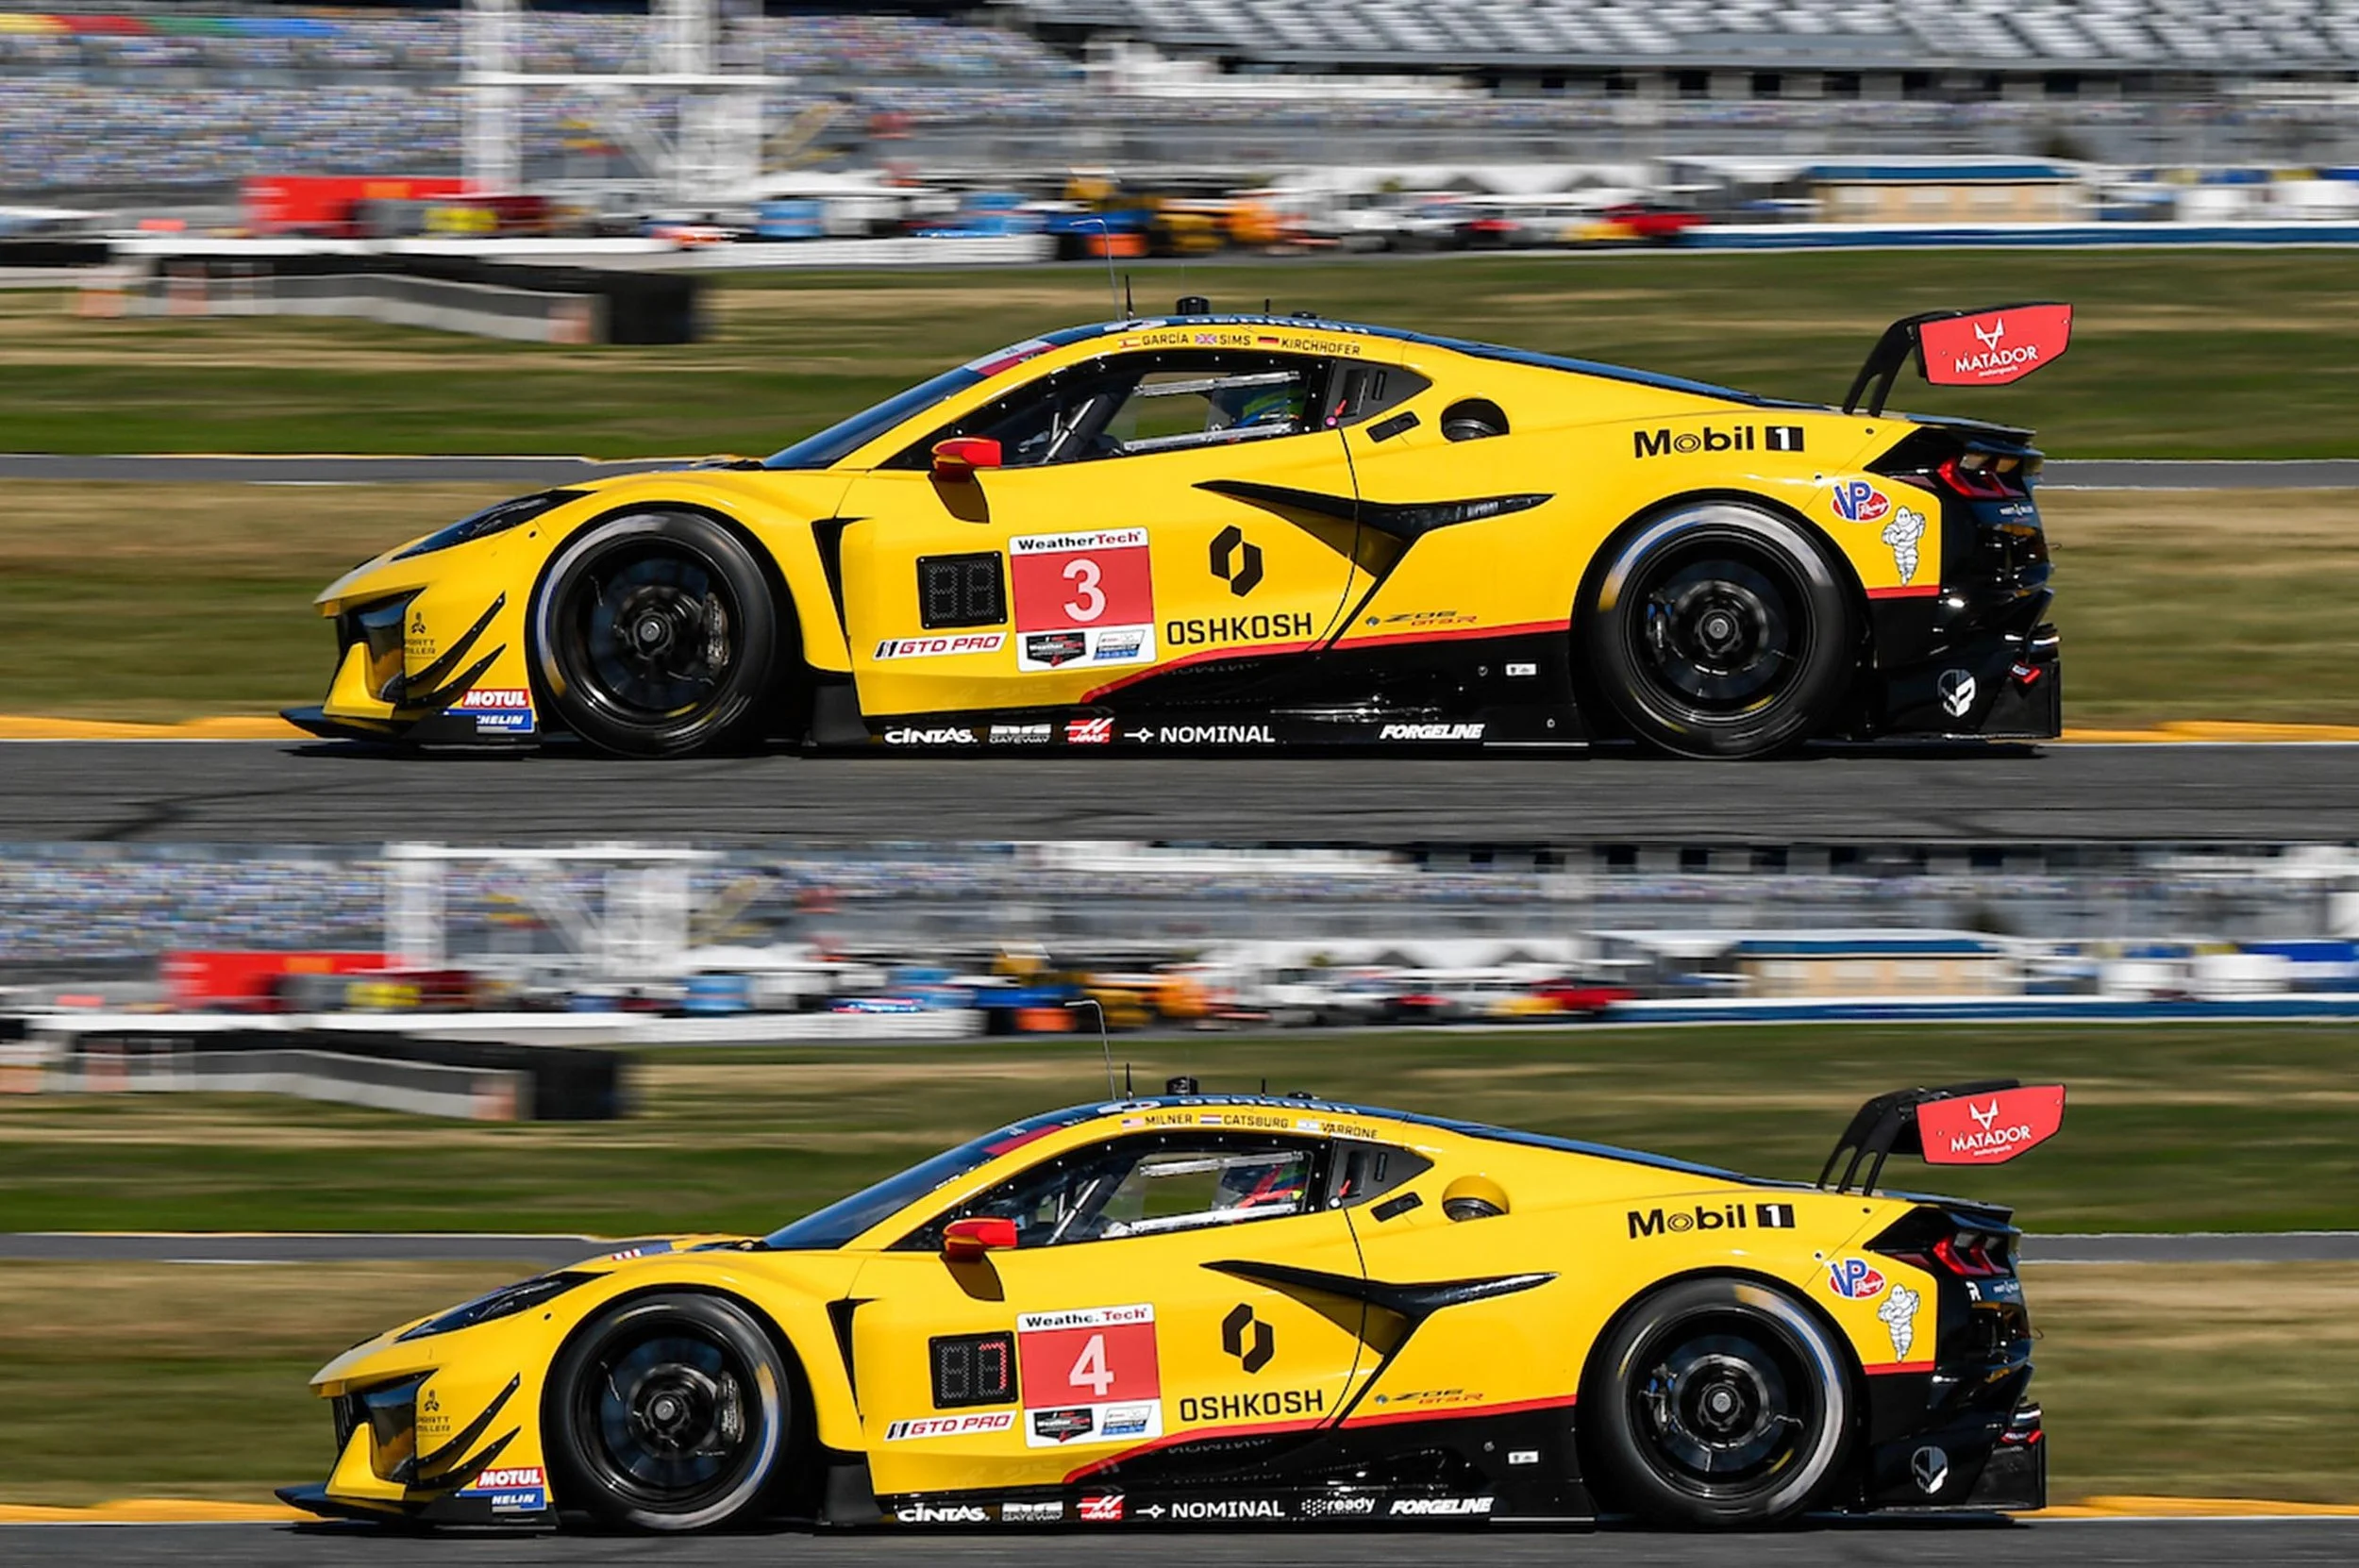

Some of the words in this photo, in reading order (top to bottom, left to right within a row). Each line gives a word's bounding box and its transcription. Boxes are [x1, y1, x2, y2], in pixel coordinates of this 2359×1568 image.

[1142, 332, 1189, 345] GARCÍA
[1220, 334, 1251, 346] SIMS
[1281, 337, 1360, 356] KIRCHHOFER
[1955, 345, 2038, 373] MATADOR
[1634, 426, 1754, 458] Mobil
[1834, 481, 1872, 520] VP
[1062, 559, 1107, 623] 3
[1167, 612, 1312, 645] OSHKOSH
[899, 640, 946, 655] GTD
[951, 636, 1001, 652] PRO
[464, 692, 527, 707] MOTUL
[1161, 725, 1276, 743] NOMINAL
[1380, 724, 1484, 741] FORGELINE
[1146, 1113, 1193, 1126] MILNER
[1224, 1114, 1289, 1129] CATSBURG
[1950, 1125, 2031, 1153] MATADOR
[1628, 1204, 1746, 1239] Mobil
[1832, 1259, 1868, 1297] VP
[1069, 1334, 1114, 1396] 4
[1180, 1389, 1323, 1423] OSHKOSH
[911, 1419, 957, 1436] GTD
[962, 1414, 1011, 1430] PRO
[479, 1469, 542, 1486] MOTUL
[1171, 1500, 1285, 1519] NOMINAL
[1327, 1497, 1376, 1513] ready
[1390, 1497, 1495, 1515] FORGELINE
